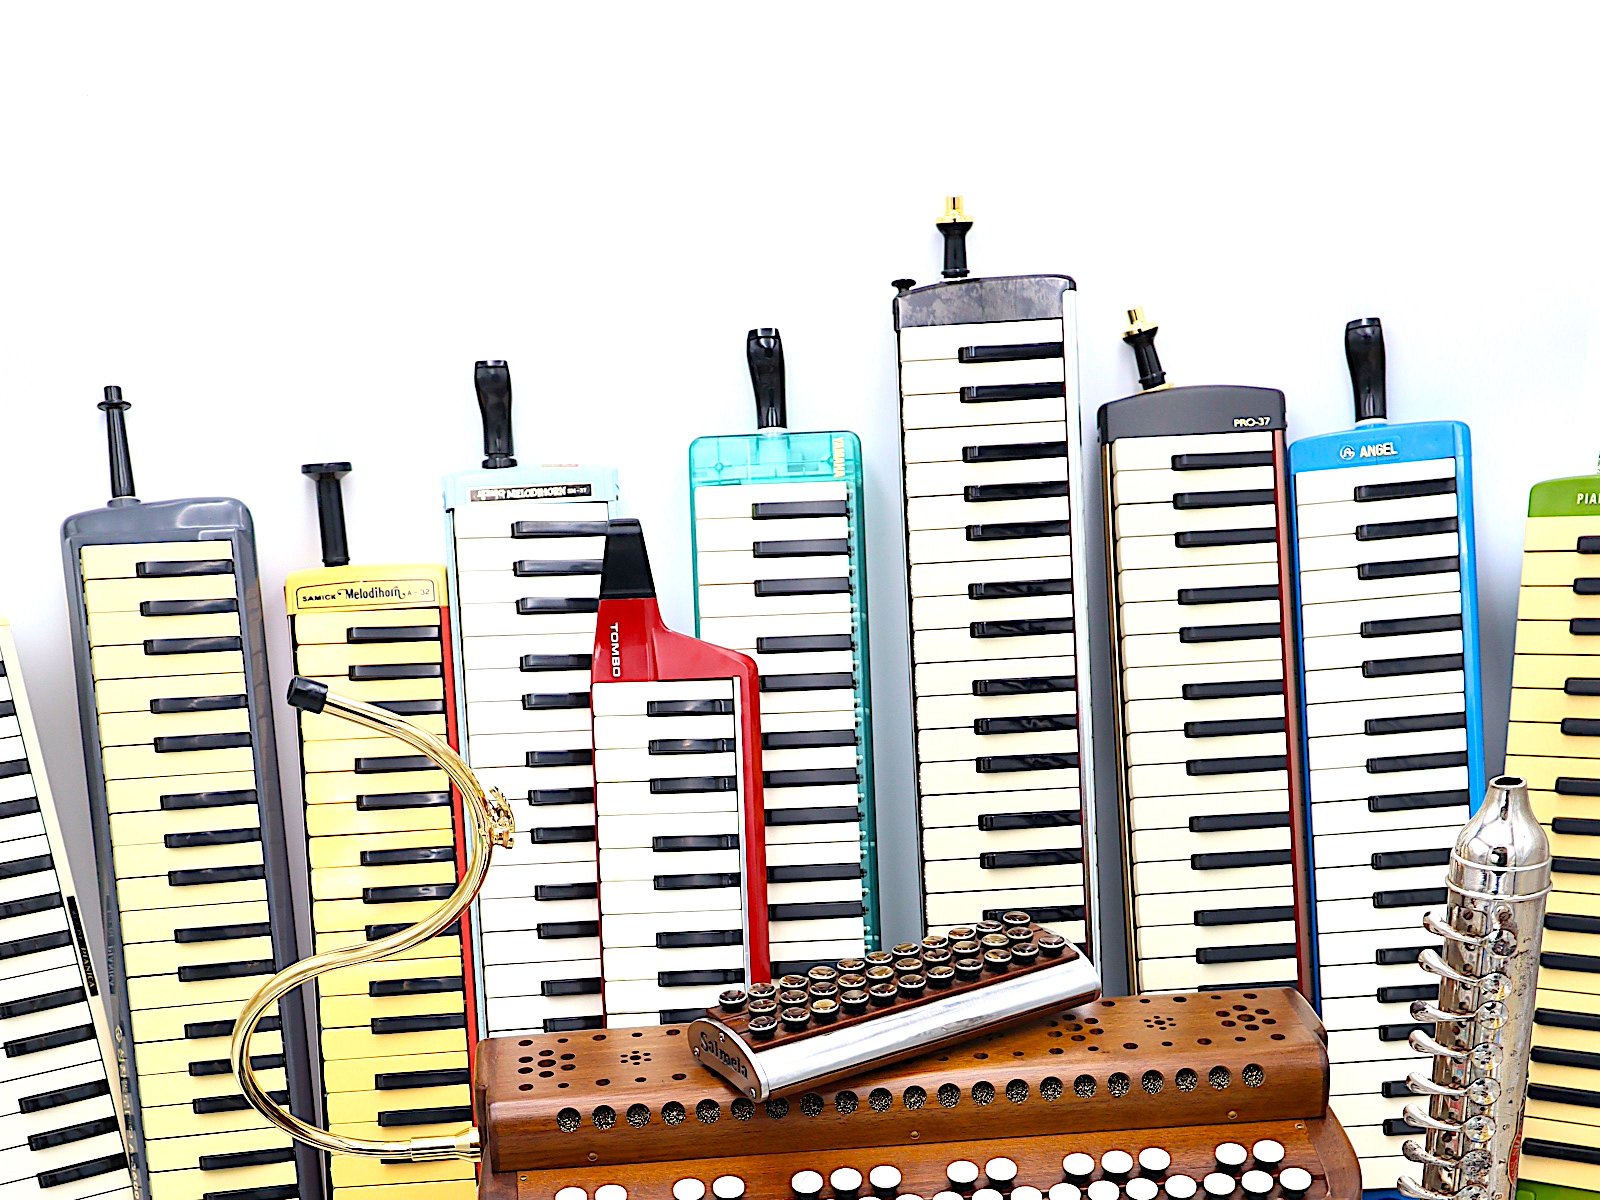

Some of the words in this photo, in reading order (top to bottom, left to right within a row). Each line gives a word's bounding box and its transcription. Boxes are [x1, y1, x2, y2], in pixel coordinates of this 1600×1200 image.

[1233, 416, 1271, 428] PRO-37
[1359, 441, 1399, 458] ANGEL
[1576, 492, 1600, 505] PIA
[302, 594, 336, 602] SAMICK
[337, 586, 406, 600] Melodihorn
[609, 621, 621, 678] TOMBO
[80, 947, 96, 988] PIANICA
[700, 1031, 749, 1080] Salmela
